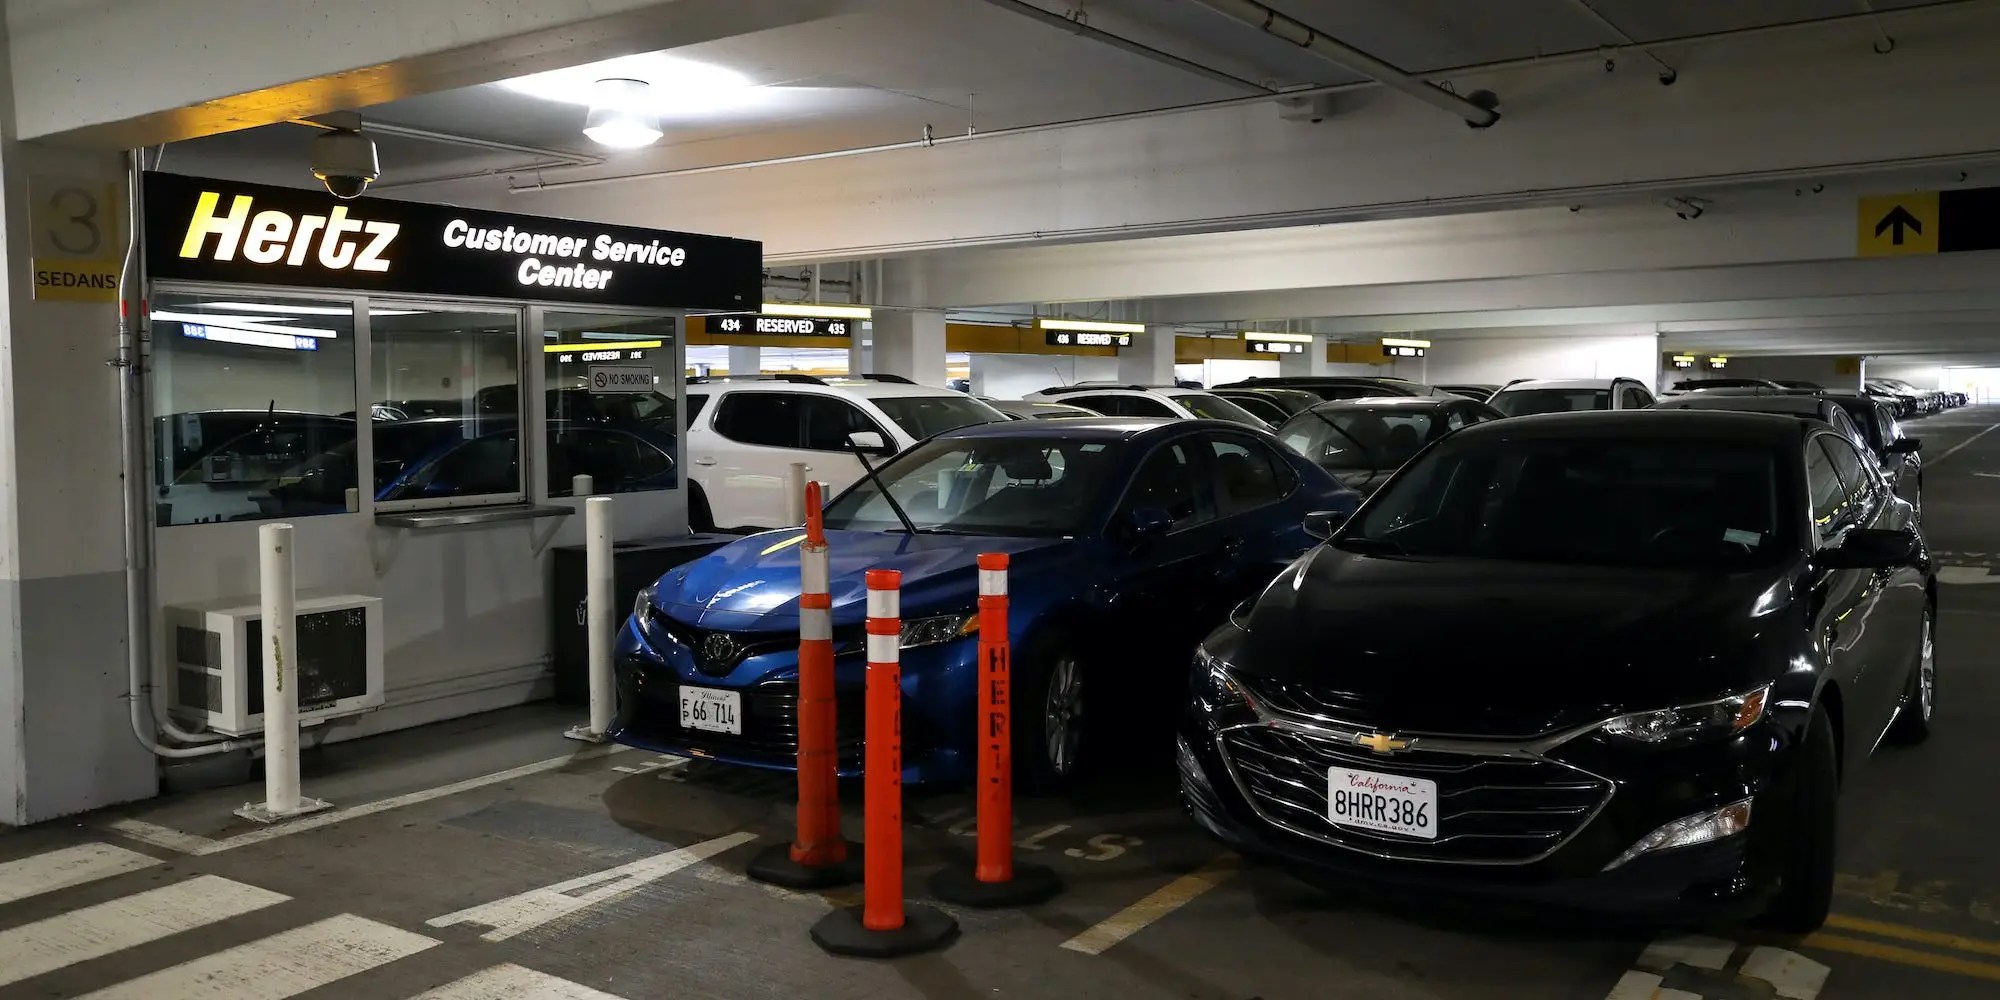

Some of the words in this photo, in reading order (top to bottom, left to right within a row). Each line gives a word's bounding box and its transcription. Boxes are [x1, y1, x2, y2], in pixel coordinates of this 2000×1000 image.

[48, 186, 101, 255] 3
[179, 191, 400, 272] Hertz
[443, 219, 588, 257] Customer
[592, 234, 686, 266] Service
[38, 271, 117, 289] SEDANS
[517, 257, 613, 289] Center
[720, 318, 741, 331] 434
[756, 318, 814, 334] RESERVED
[828, 323, 846, 335] 435
[609, 374, 619, 385] NO
[620, 374, 650, 385] SMOKING
[692, 700, 707, 721] 66
[713, 702, 735, 725] 714
[1350, 774, 1416, 795] California
[1335, 789, 1429, 828] 8HRR386
